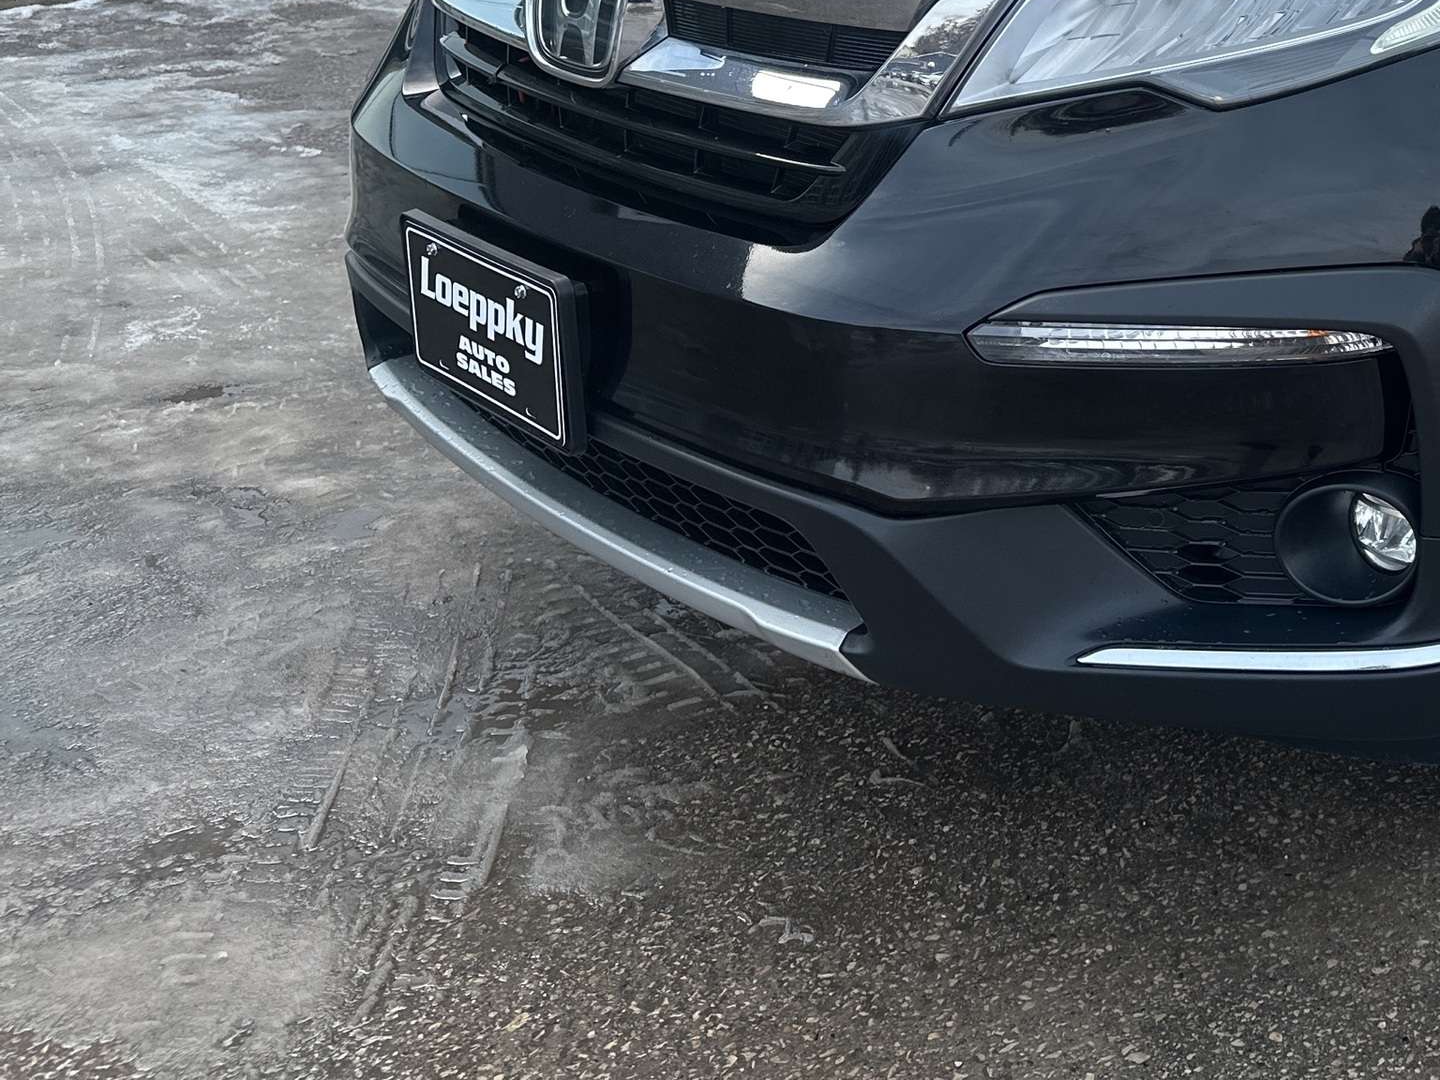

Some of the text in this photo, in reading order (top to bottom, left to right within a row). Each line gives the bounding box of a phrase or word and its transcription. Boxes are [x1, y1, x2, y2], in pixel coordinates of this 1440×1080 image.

[420, 255, 544, 366] Loeppky
[456, 351, 517, 397] SALES
[458, 335, 511, 375] AUTO
